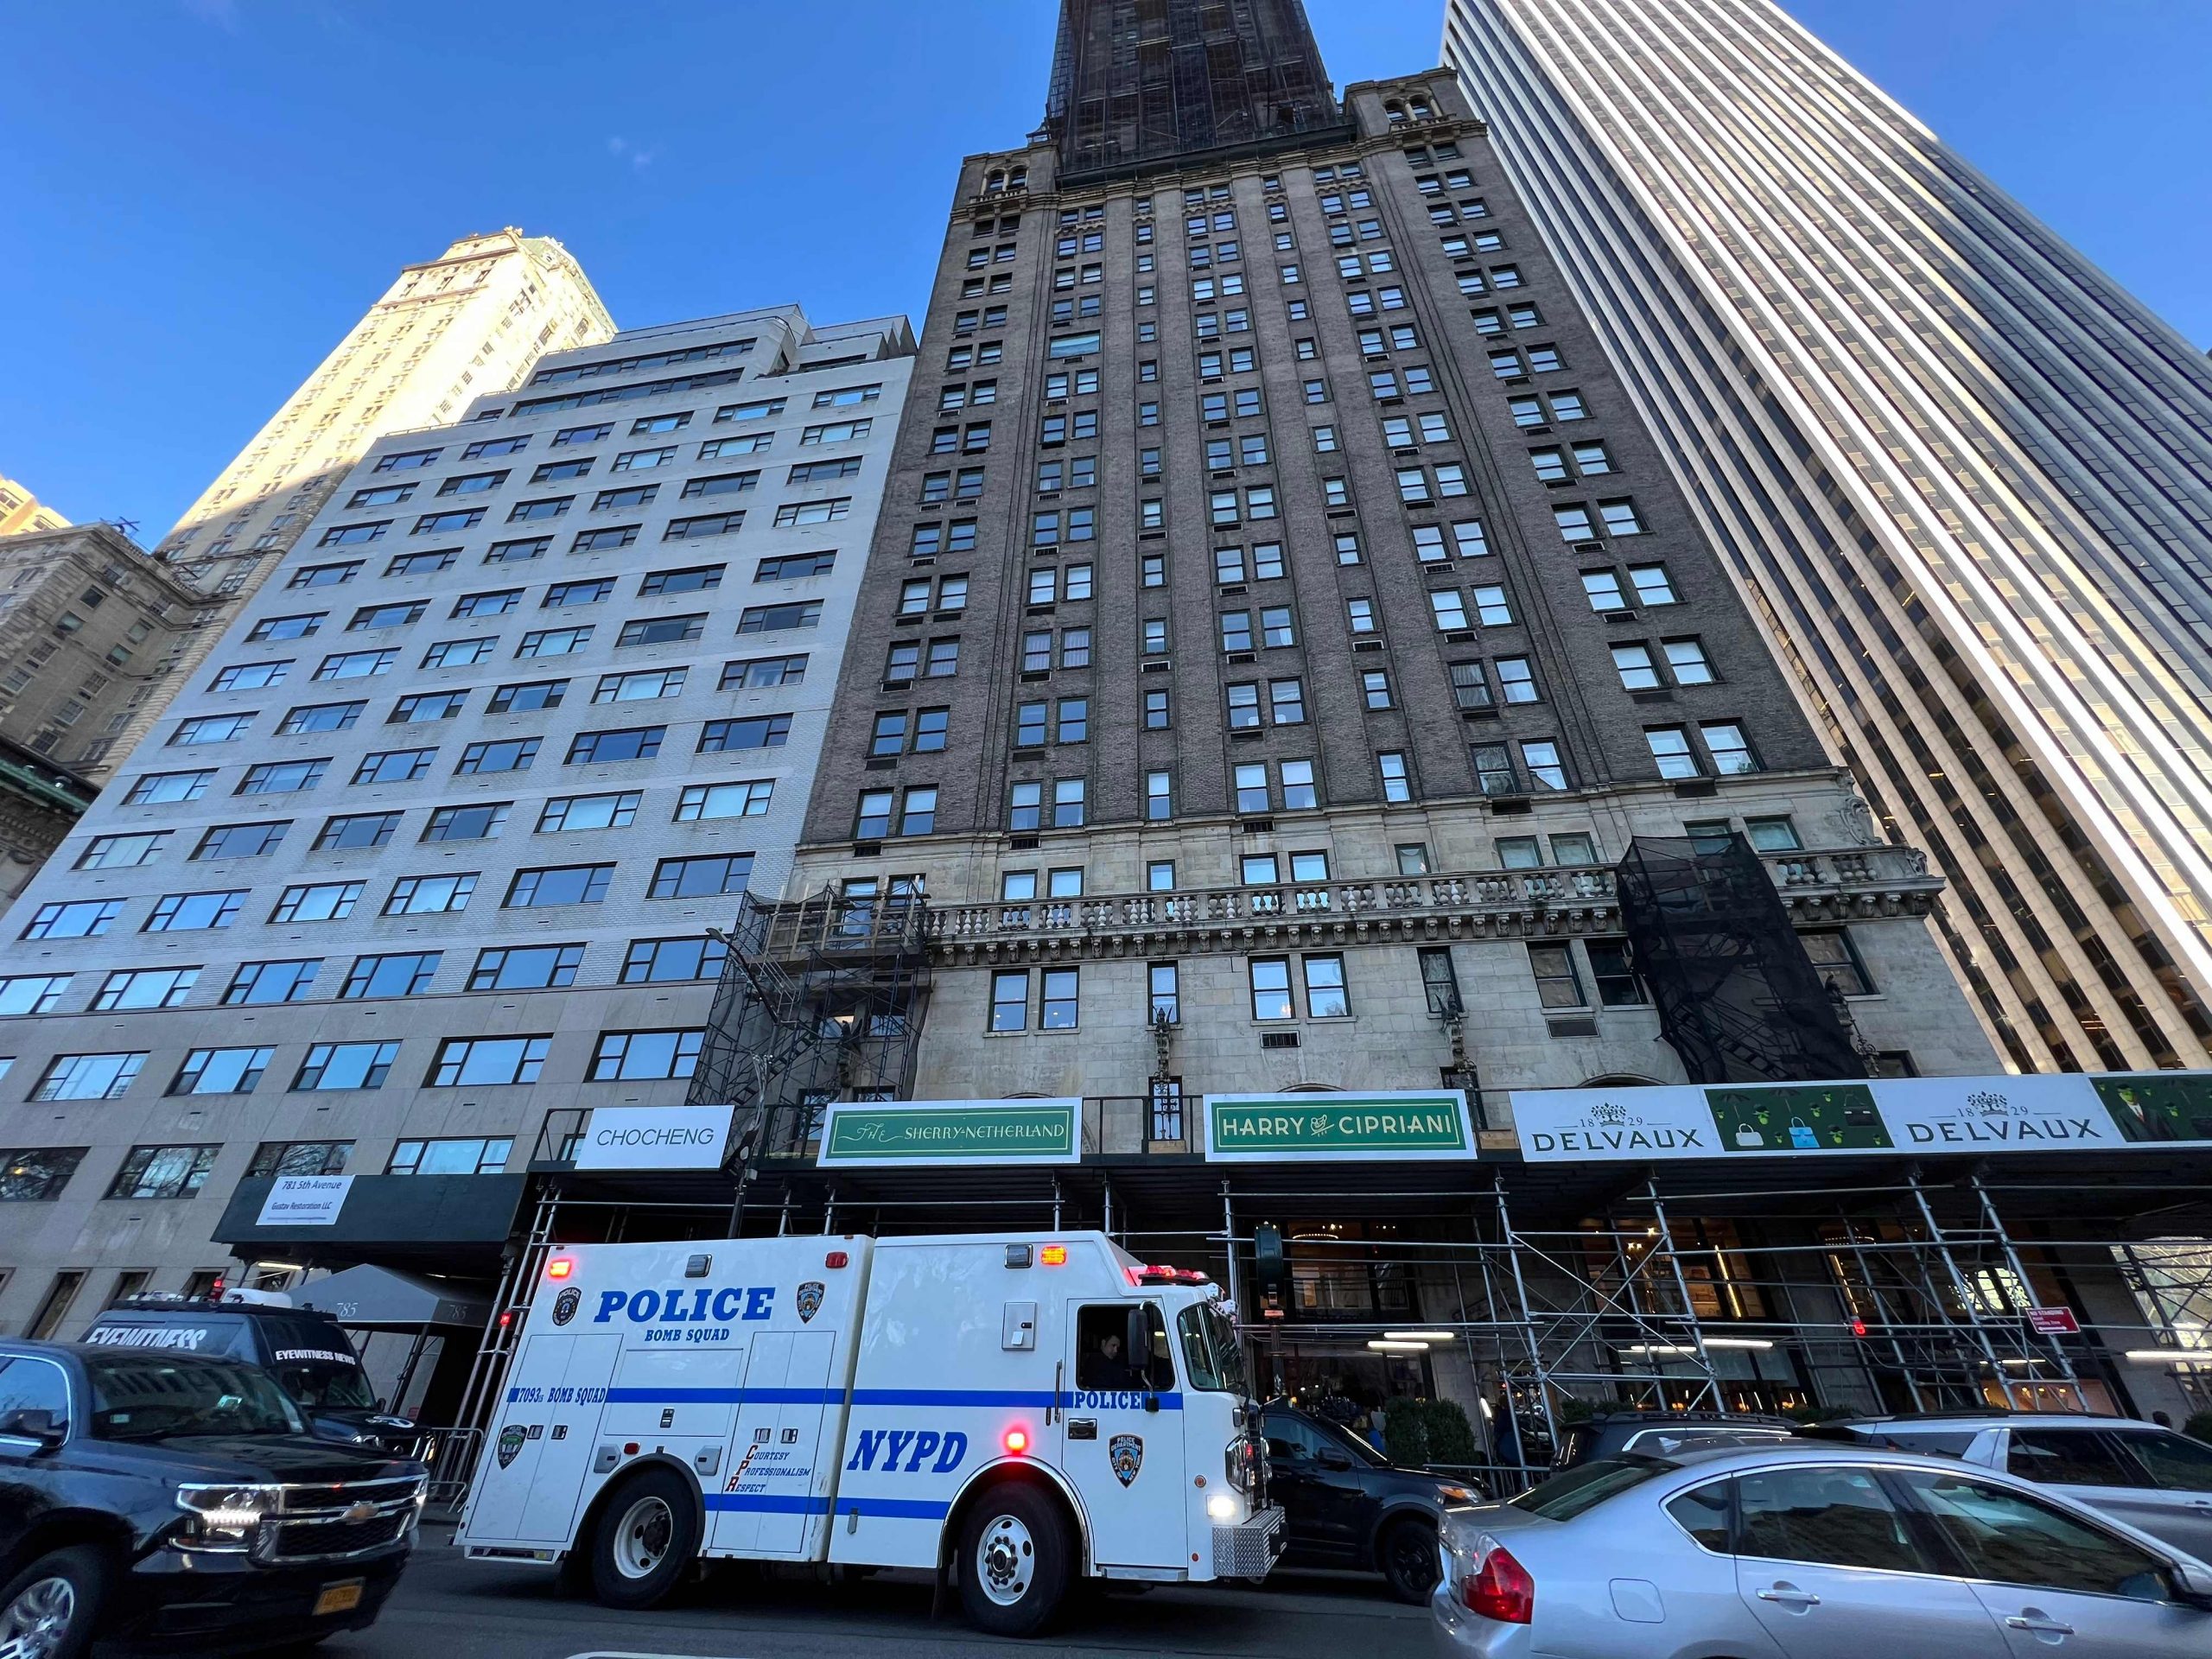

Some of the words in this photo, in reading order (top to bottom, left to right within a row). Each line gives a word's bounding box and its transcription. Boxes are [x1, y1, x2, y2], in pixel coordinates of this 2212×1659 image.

[1957, 1108, 1974, 1117] 18
[2011, 1106, 2028, 1116] 29
[1223, 1116, 1305, 1136] HARRY
[1339, 1115, 1452, 1135] CIPRIANI
[1580, 1118, 1595, 1128] 18
[1629, 1116, 1643, 1126] 29
[597, 1128, 714, 1146] CHOCHENG
[904, 1124, 1065, 1141] SHERRY-NETHERLAND
[1905, 1119, 2102, 1142] DELVAUX
[1532, 1128, 1704, 1152] DELVAUX
[282, 1180, 296, 1190] 781
[296, 1180, 310, 1190] 5th
[311, 1180, 342, 1190] Avenue
[321, 1201, 333, 1210] LLC
[337, 1302, 359, 1317] 785
[449, 1305, 468, 1319] 785
[594, 1287, 776, 1323] POLICE
[86, 1327, 207, 1350] EYEWITNESS
[645, 1329, 681, 1342] BOMB
[685, 1328, 730, 1343] SQUAD
[276, 1350, 334, 1360] EYEWITNESS
[334, 1352, 355, 1365] NEWS
[518, 1387, 541, 1403] 7093
[547, 1387, 574, 1403] BOMB
[575, 1387, 606, 1406] SQUAD
[1074, 1390, 1141, 1409] POLICE
[746, 1445, 790, 1460] COURTESY
[846, 1430, 968, 1473] NYPD
[1110, 1442, 1141, 1452] DEPARTMENT
[735, 1460, 811, 1477] PROFESSIONALISM
[725, 1476, 766, 1492] RESPECT
